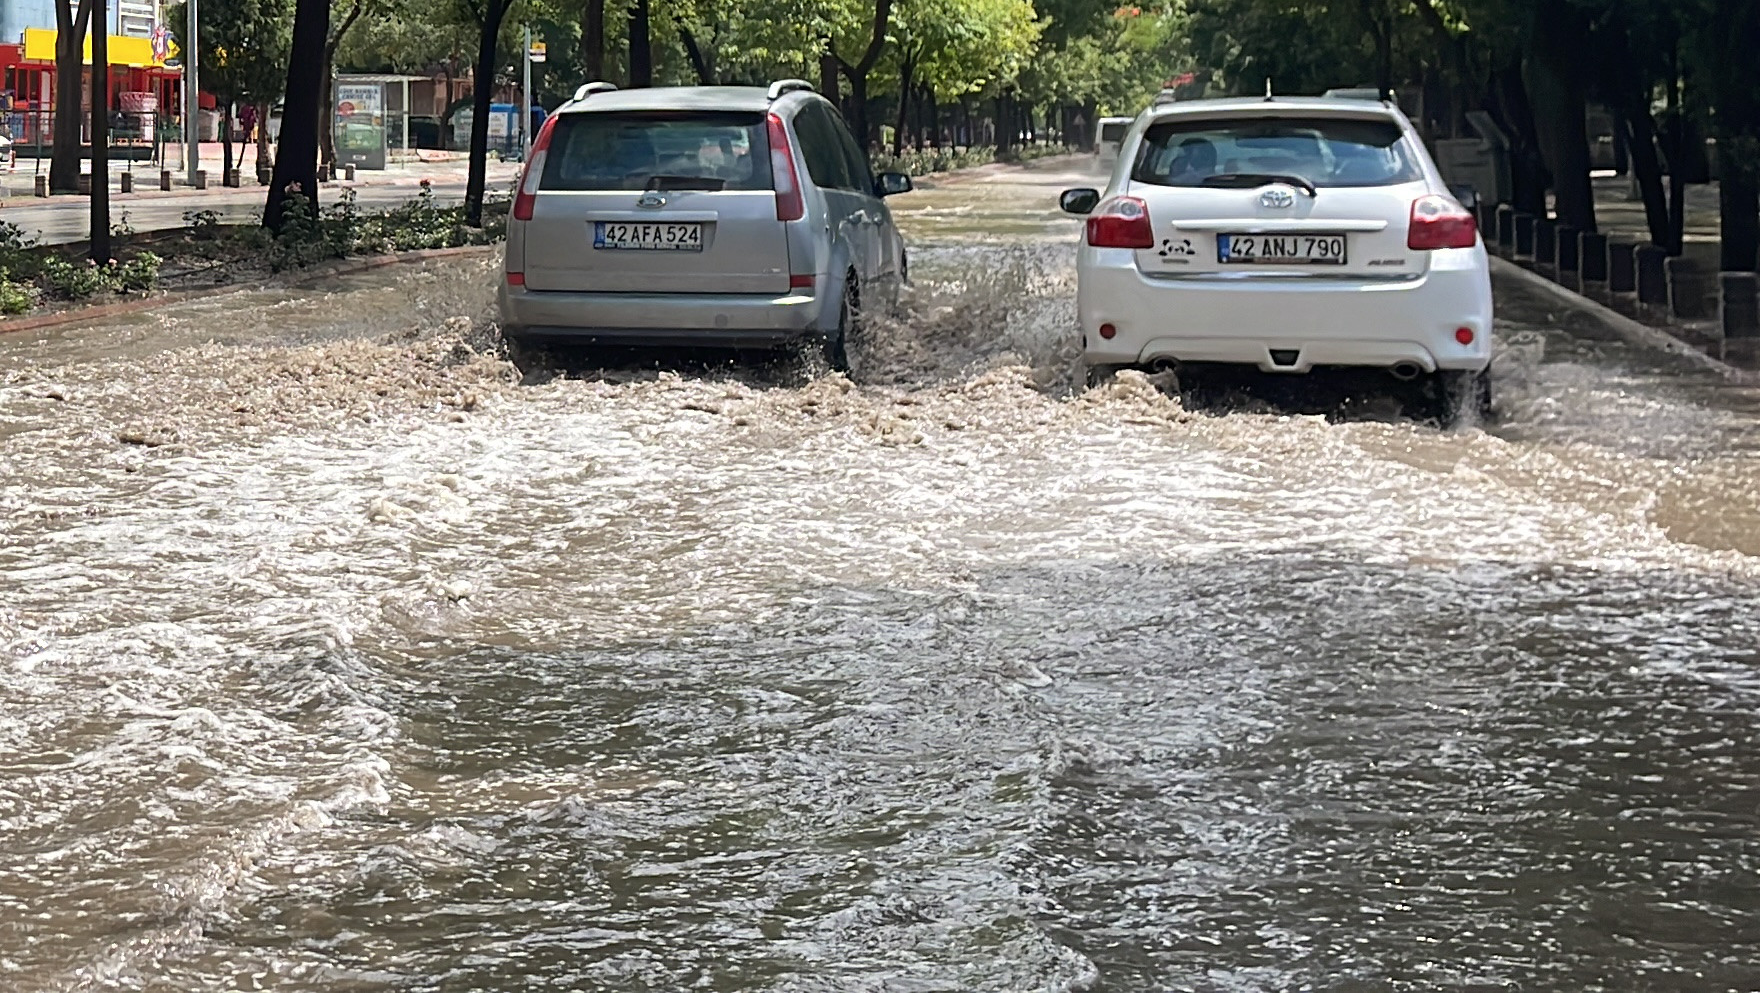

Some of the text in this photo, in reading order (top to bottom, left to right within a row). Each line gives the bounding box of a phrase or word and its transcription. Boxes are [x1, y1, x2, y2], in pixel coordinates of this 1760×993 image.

[606, 226, 699, 243] 42 AFA 524
[1231, 237, 1342, 257] 42 ANJ 790
